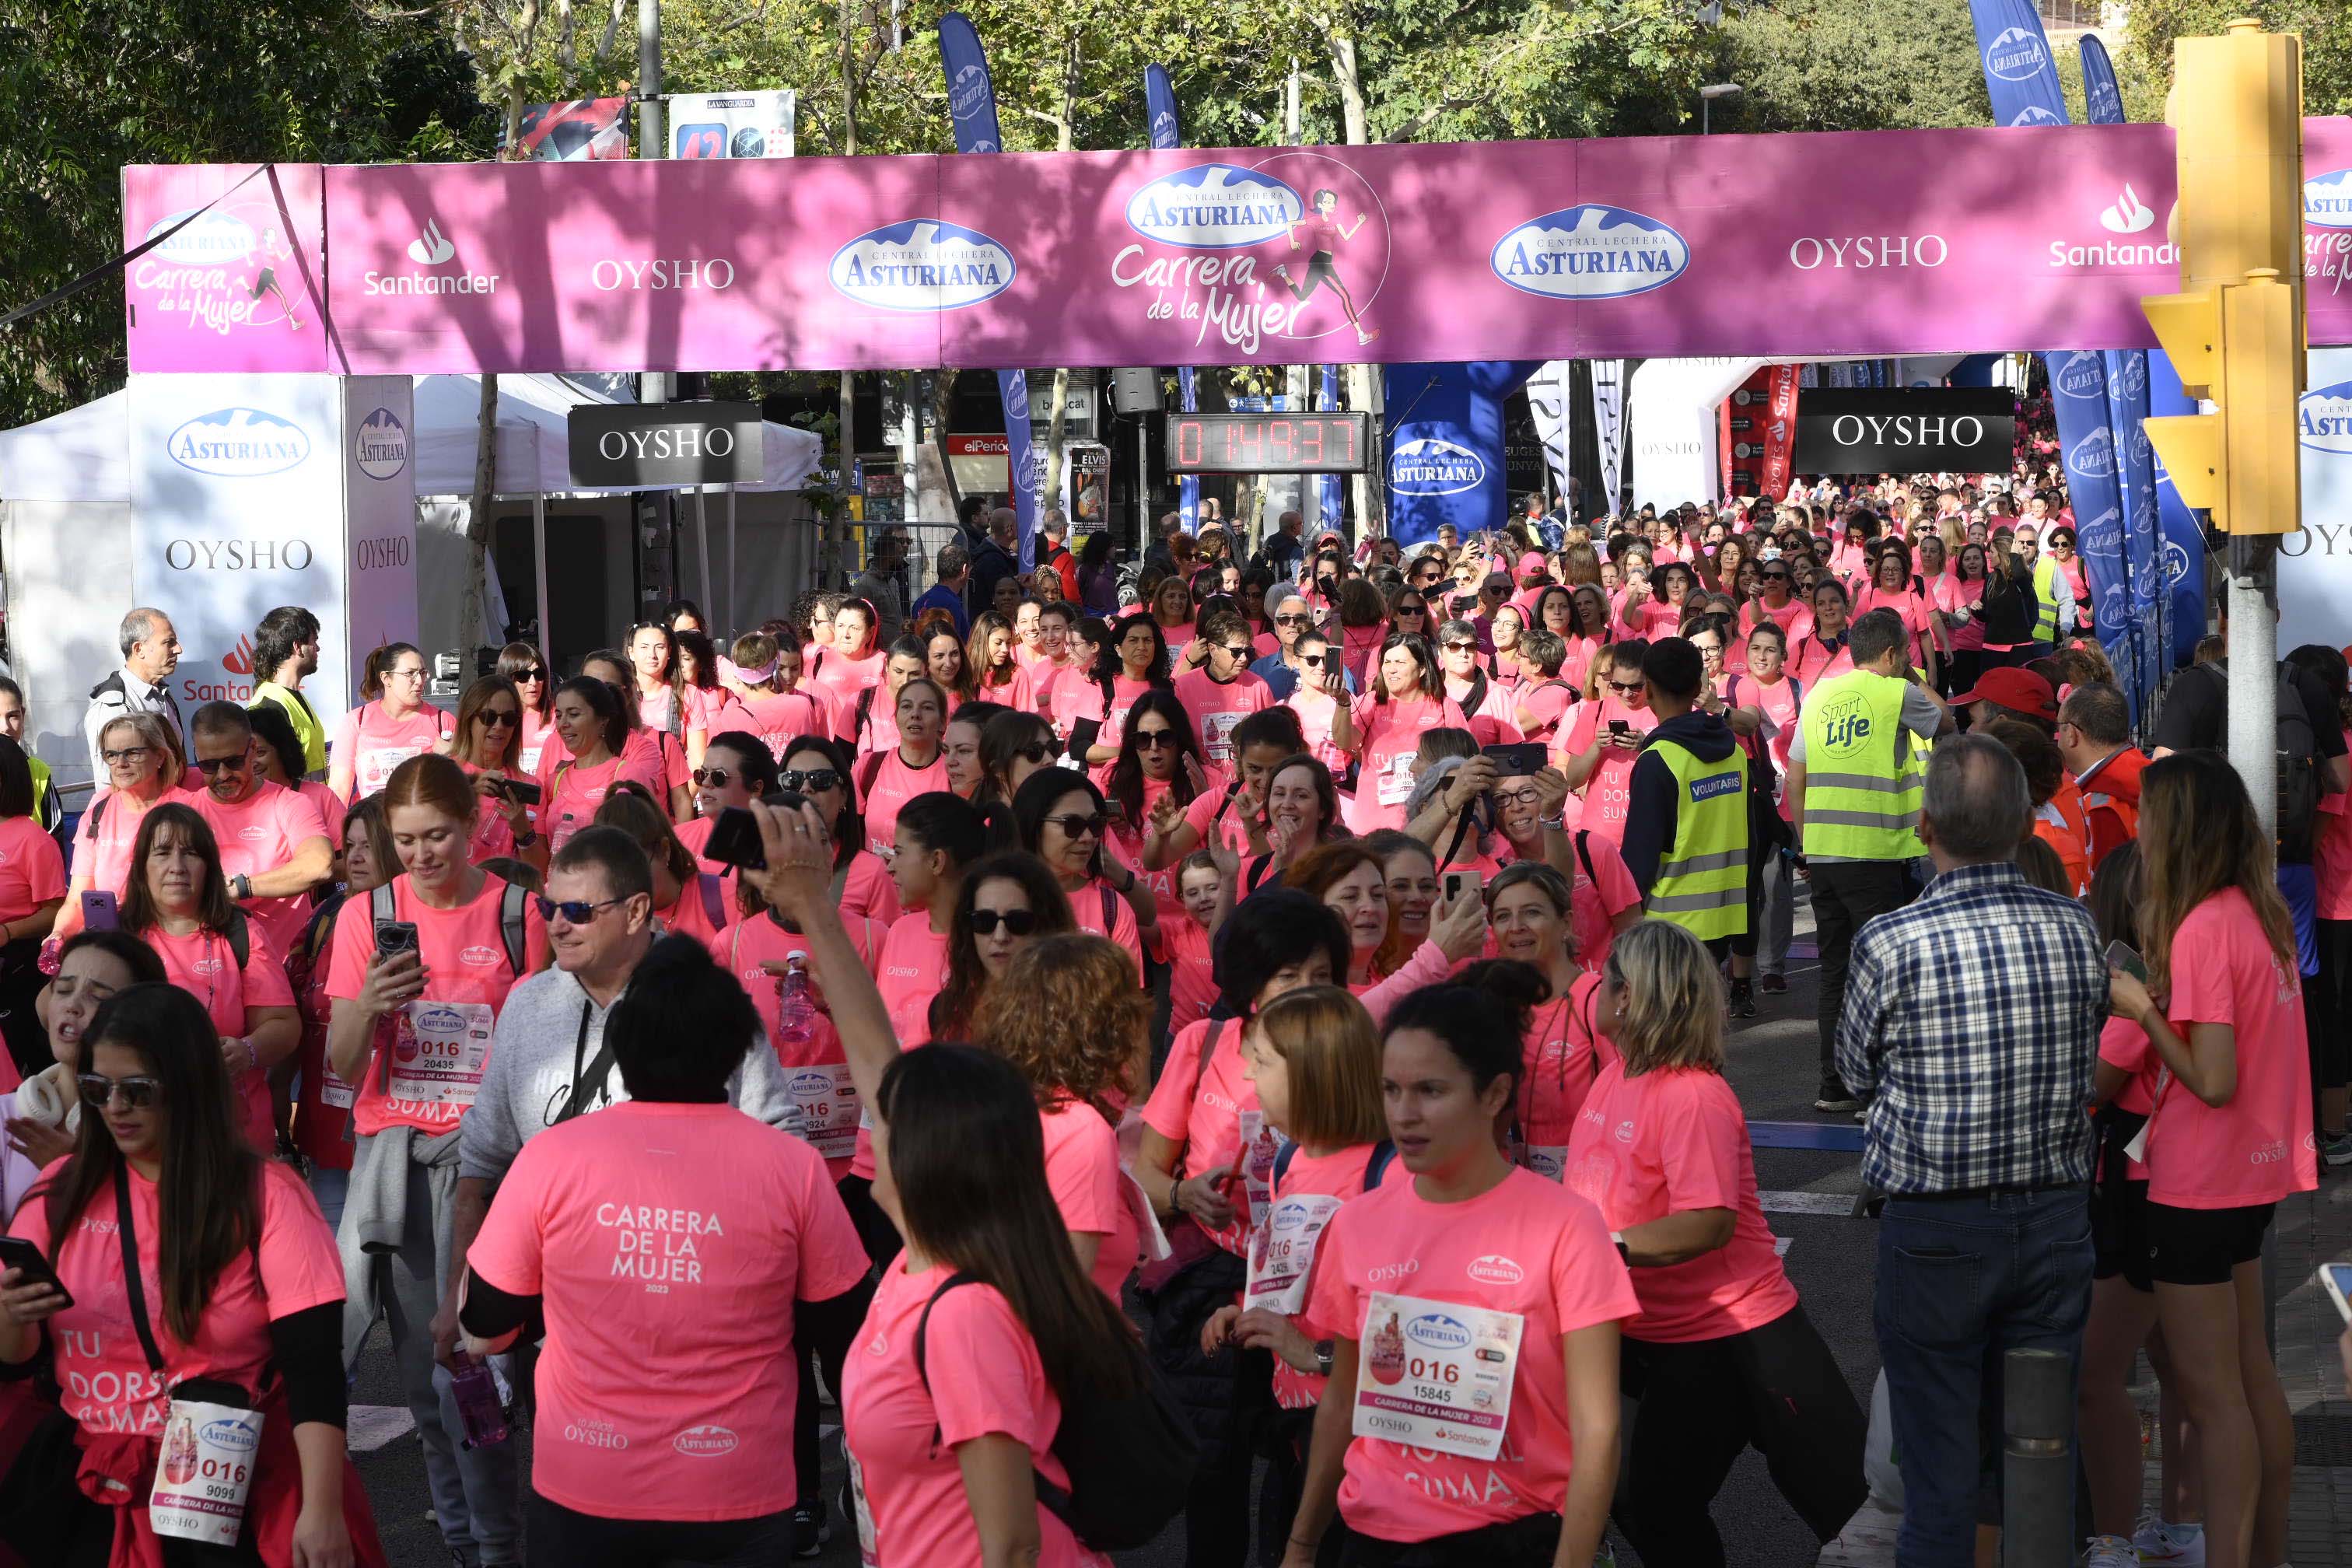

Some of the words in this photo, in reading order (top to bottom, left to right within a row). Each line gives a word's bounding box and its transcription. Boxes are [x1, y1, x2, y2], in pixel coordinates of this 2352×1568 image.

[1139, 197, 1289, 226] ASTURIANA
[1537, 236, 1599, 247] CENTRAL
[1605, 235, 1668, 246] LECHERA
[1790, 234, 1948, 270] OYSHO
[843, 254, 1002, 286] ASTURIANA
[1111, 245, 1258, 286] Carrera
[1507, 240, 1673, 276] ASTURIANA
[135, 261, 226, 289] Carrera
[365, 270, 499, 295] Santander
[592, 258, 734, 291] OYSHO
[158, 295, 175, 311] de
[179, 291, 191, 311] la
[189, 285, 261, 335] Mujer
[1147, 289, 1174, 320] de
[1181, 289, 1199, 319] la
[1196, 282, 1311, 355] Mujer
[1832, 414, 1983, 447] OYSHO
[179, 434, 299, 459] ASTURIANA
[359, 435, 404, 461] ASTURIANA
[597, 427, 737, 461] OYSHO
[1082, 455, 1106, 464] ELVIS
[1391, 464, 1477, 484] ASTURIANA
[166, 540, 312, 570] OYSHO
[357, 536, 409, 570] OYSHO
[1821, 696, 1861, 723] Sport
[1825, 714, 1870, 747] Life
[1604, 771, 1619, 784] TU
[1692, 777, 1741, 796] VOLUNTARIS
[887, 965, 919, 978] OYSHO
[421, 1018, 463, 1028] ASTURIANA
[422, 1041, 460, 1055] 016
[424, 1059, 454, 1069] 20435
[395, 1083, 425, 1094] OYSHO
[597, 1203, 723, 1237] CARRERA
[619, 1230, 653, 1255] DE
[664, 1234, 697, 1259] LA
[1269, 1239, 1291, 1258] 016
[611, 1256, 702, 1284] MUJER
[1368, 1258, 1419, 1283] OYSHO
[61, 1329, 100, 1359] TU
[1409, 1324, 1466, 1345] ASTURIANA
[1410, 1358, 1460, 1384] 016
[1413, 1385, 1451, 1402] 15845
[1375, 1397, 1413, 1412] CARRERA
[1415, 1404, 1426, 1413] DE
[1427, 1406, 1439, 1416] LA
[1440, 1409, 1470, 1422] MUJER
[565, 1424, 628, 1450] OYSHO
[1369, 1415, 1412, 1433] OYSHO
[1447, 1430, 1492, 1447] Santander
[202, 1459, 247, 1483] 016
[163, 1496, 201, 1509] CARRERA
[203, 1503, 214, 1511] DE
[215, 1504, 226, 1513] LA
[207, 1484, 235, 1500] 9099
